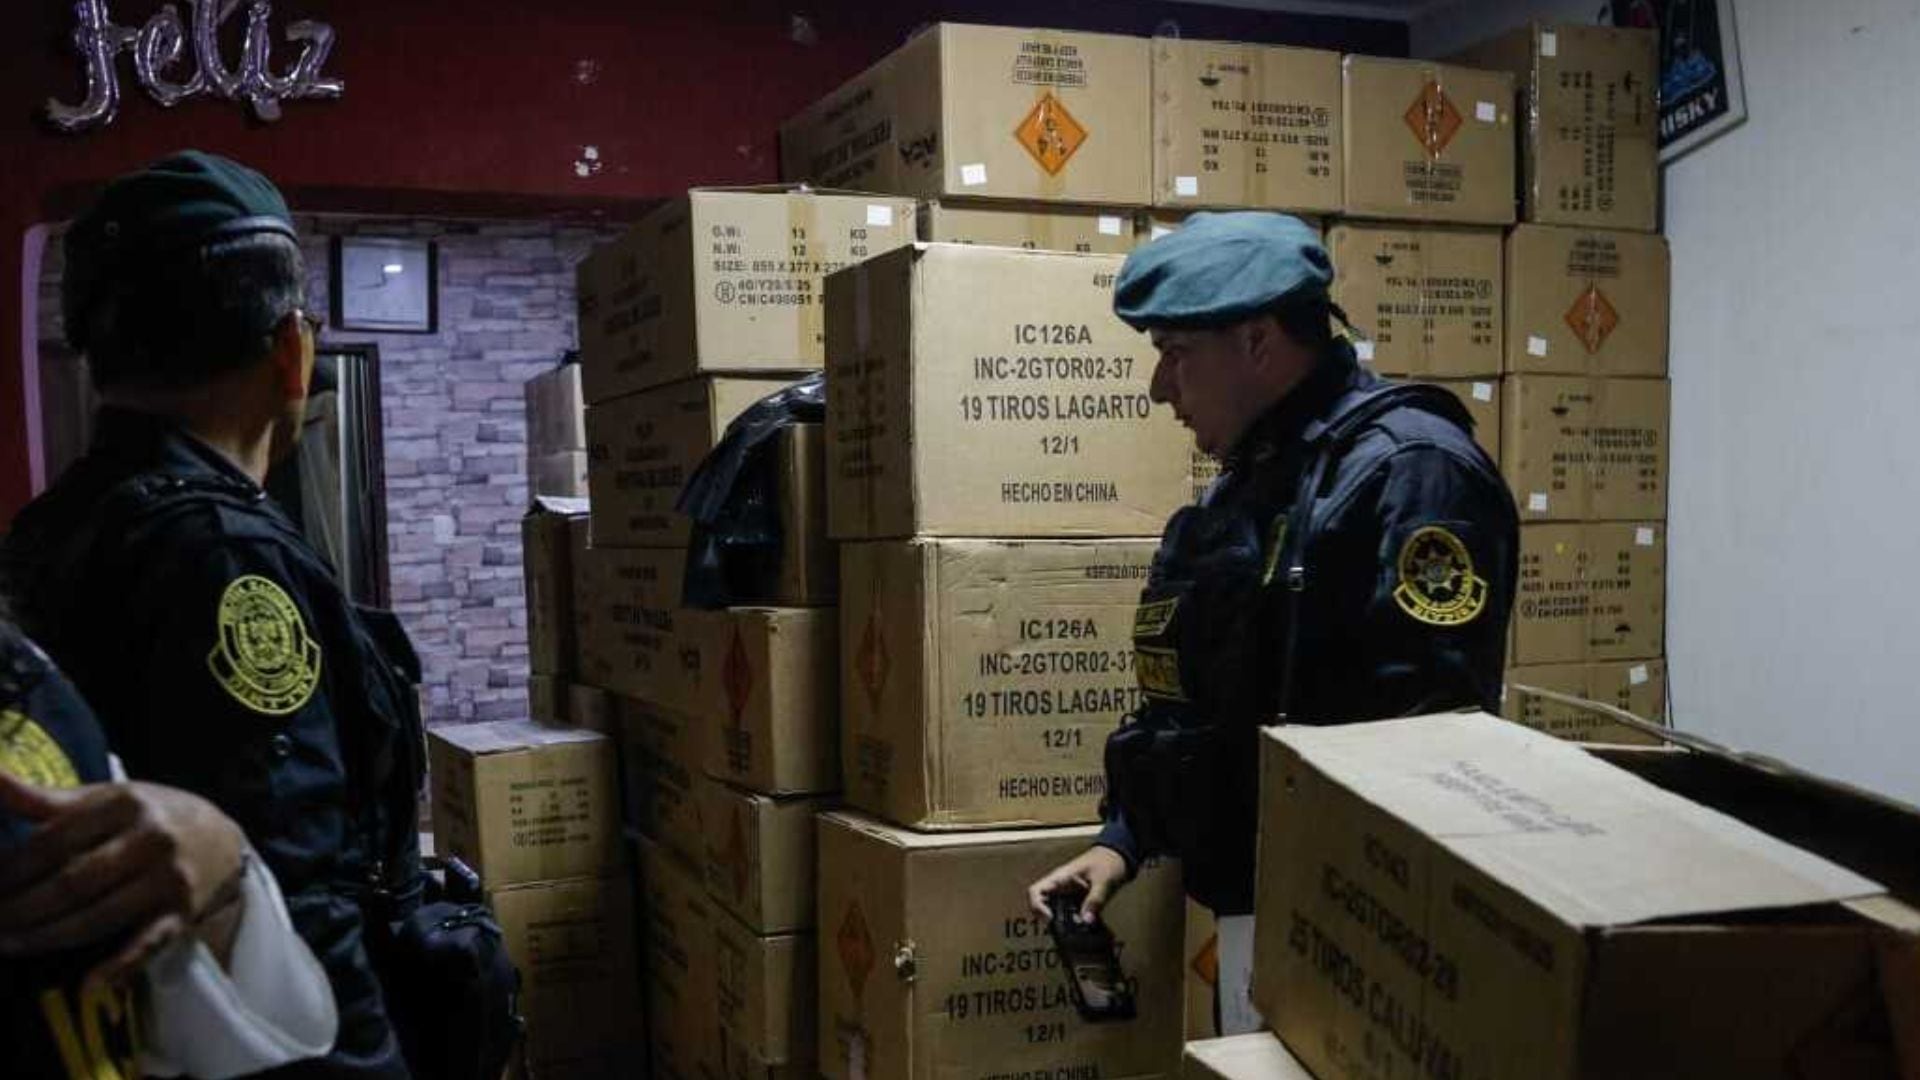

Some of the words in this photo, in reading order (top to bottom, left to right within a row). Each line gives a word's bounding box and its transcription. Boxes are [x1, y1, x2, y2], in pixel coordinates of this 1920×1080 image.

[1014, 324, 1093, 345] IC126A
[973, 356, 1135, 381] INC-2GTOR02-37
[960, 395, 983, 421] 19
[986, 394, 1050, 421] TIROS
[1054, 393, 1151, 420] LAGARTO
[1040, 435, 1080, 455] 12/1
[1001, 482, 1051, 503] HECHO
[1053, 482, 1073, 503] EN
[1075, 482, 1119, 503] CHINA
[1019, 618, 1098, 640] IC126A
[979, 650, 1137, 678] INC-2GTOR02-37
[964, 691, 987, 718] 19
[990, 689, 1051, 716] TIROS
[1042, 728, 1082, 748] 12/1
[999, 776, 1050, 800] HECHO
[1052, 776, 1072, 797] EN
[945, 992, 969, 1020] 19
[973, 985, 1037, 1017] TIROS
[1027, 1023, 1066, 1043] 12/1
